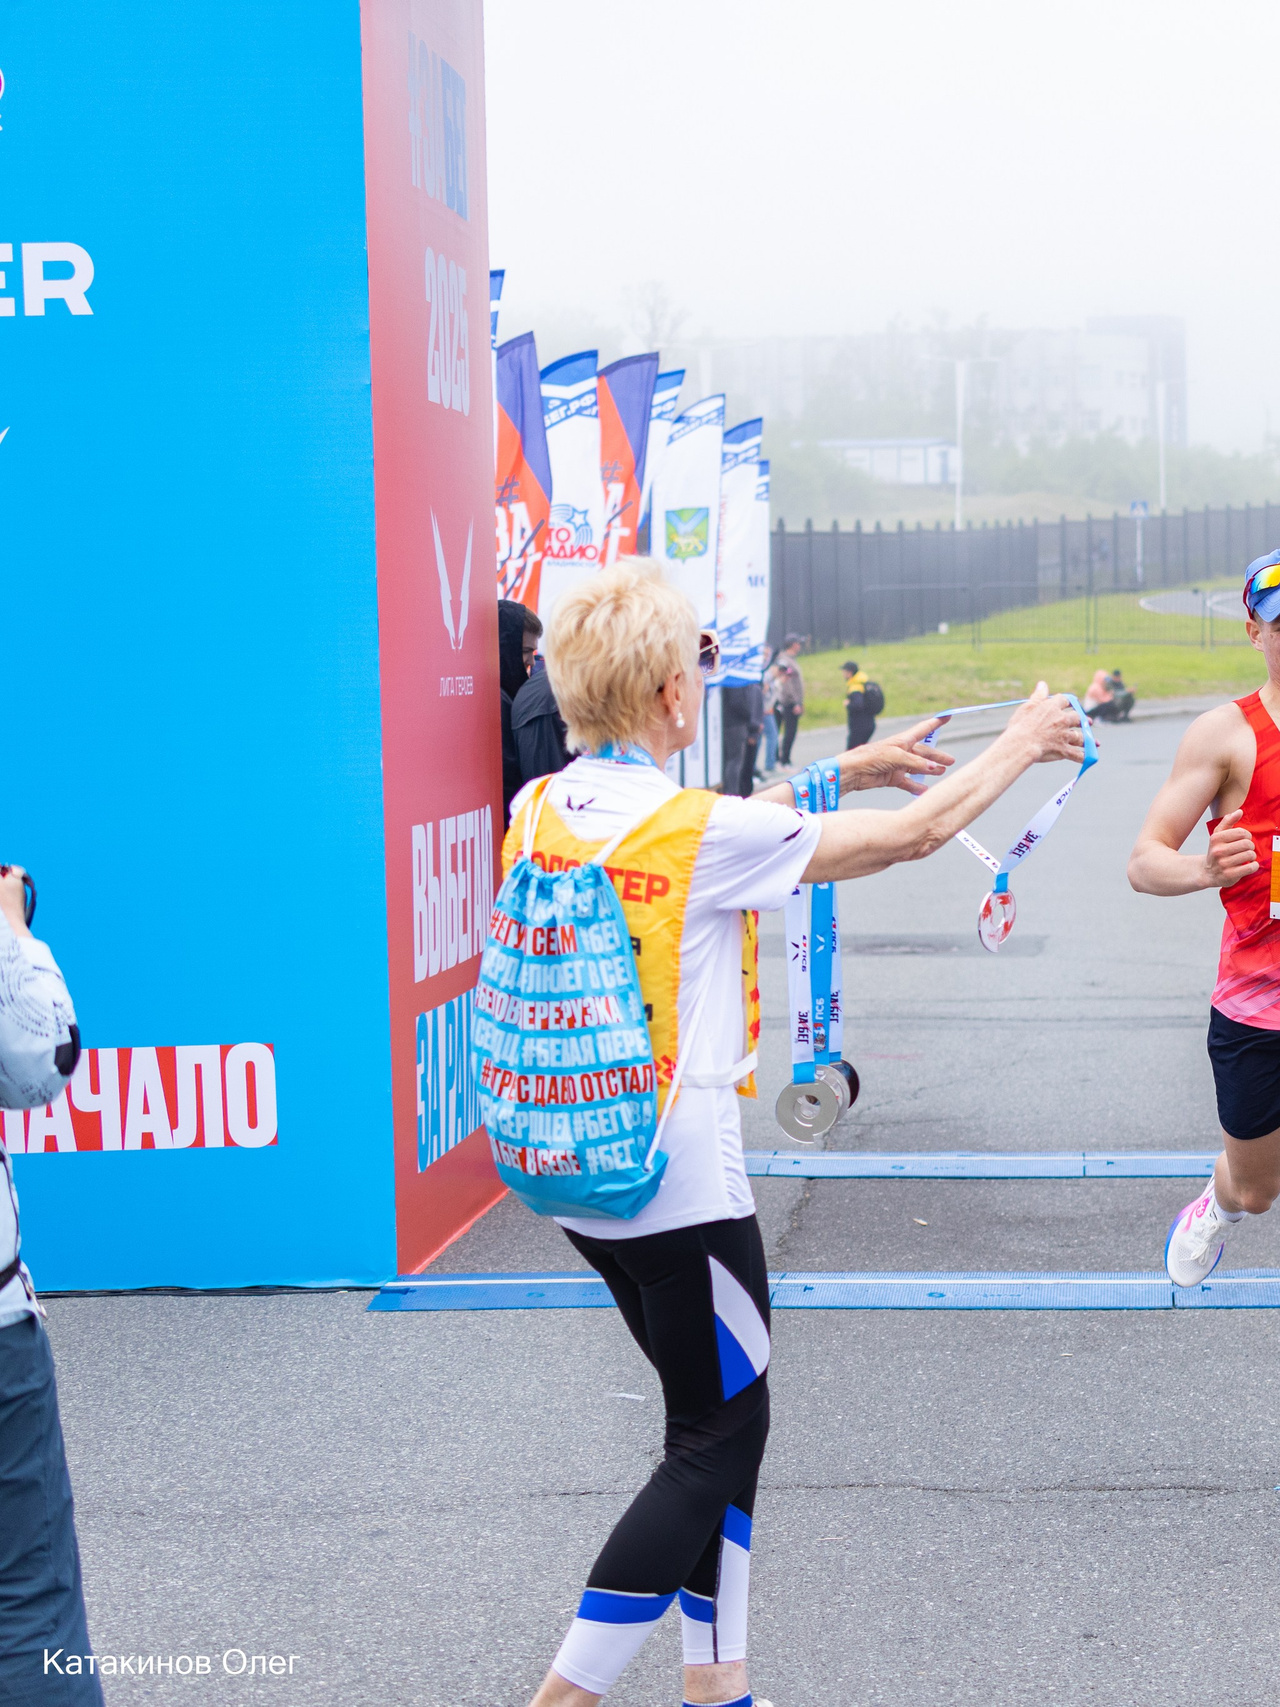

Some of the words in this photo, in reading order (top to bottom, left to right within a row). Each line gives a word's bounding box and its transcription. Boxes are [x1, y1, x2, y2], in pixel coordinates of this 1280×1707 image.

[425, 247, 470, 417] 2025
[412, 804, 494, 983] ВЫБЕГАЮ
[0, 1042, 278, 1154] АЧАЛО
[416, 1007, 442, 1173] ЗА
[580, 1064, 654, 1102] ОТСТАЛ
